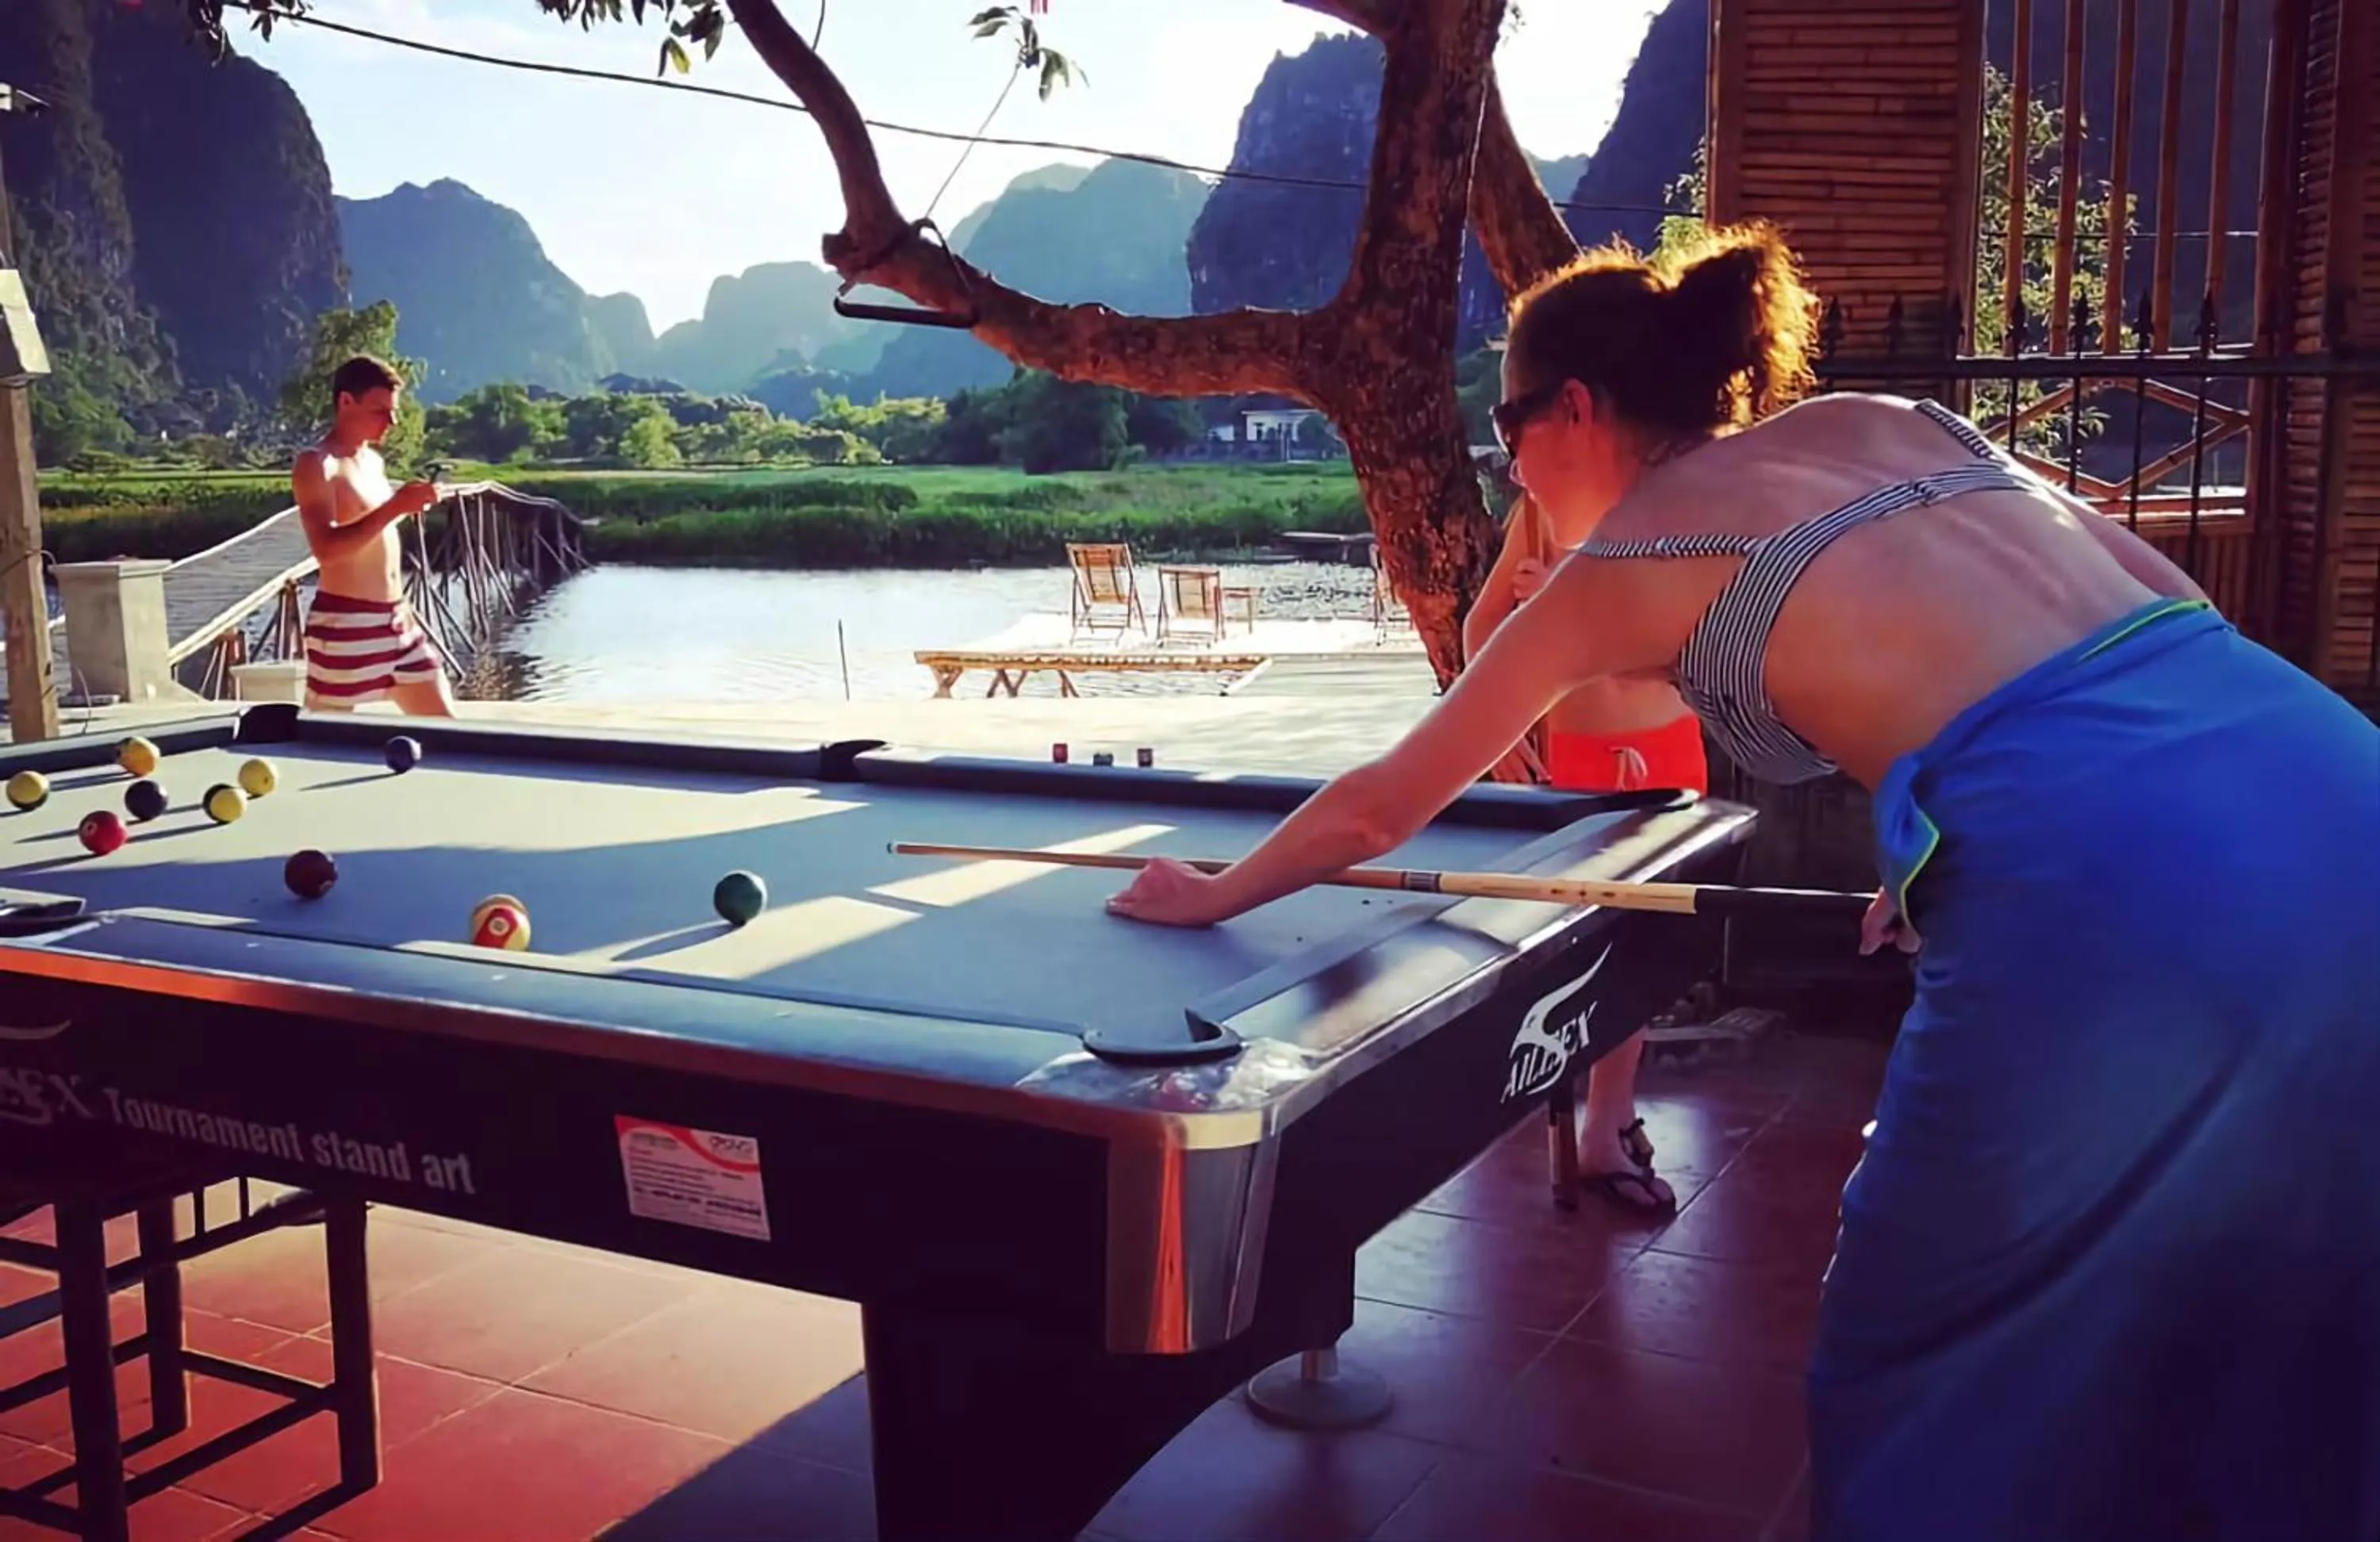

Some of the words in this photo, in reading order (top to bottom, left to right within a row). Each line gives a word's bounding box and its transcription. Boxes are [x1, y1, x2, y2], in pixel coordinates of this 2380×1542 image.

[102, 1087, 305, 1163] Tournament
[312, 1131, 411, 1183] stand
[420, 1152, 476, 1195] art
